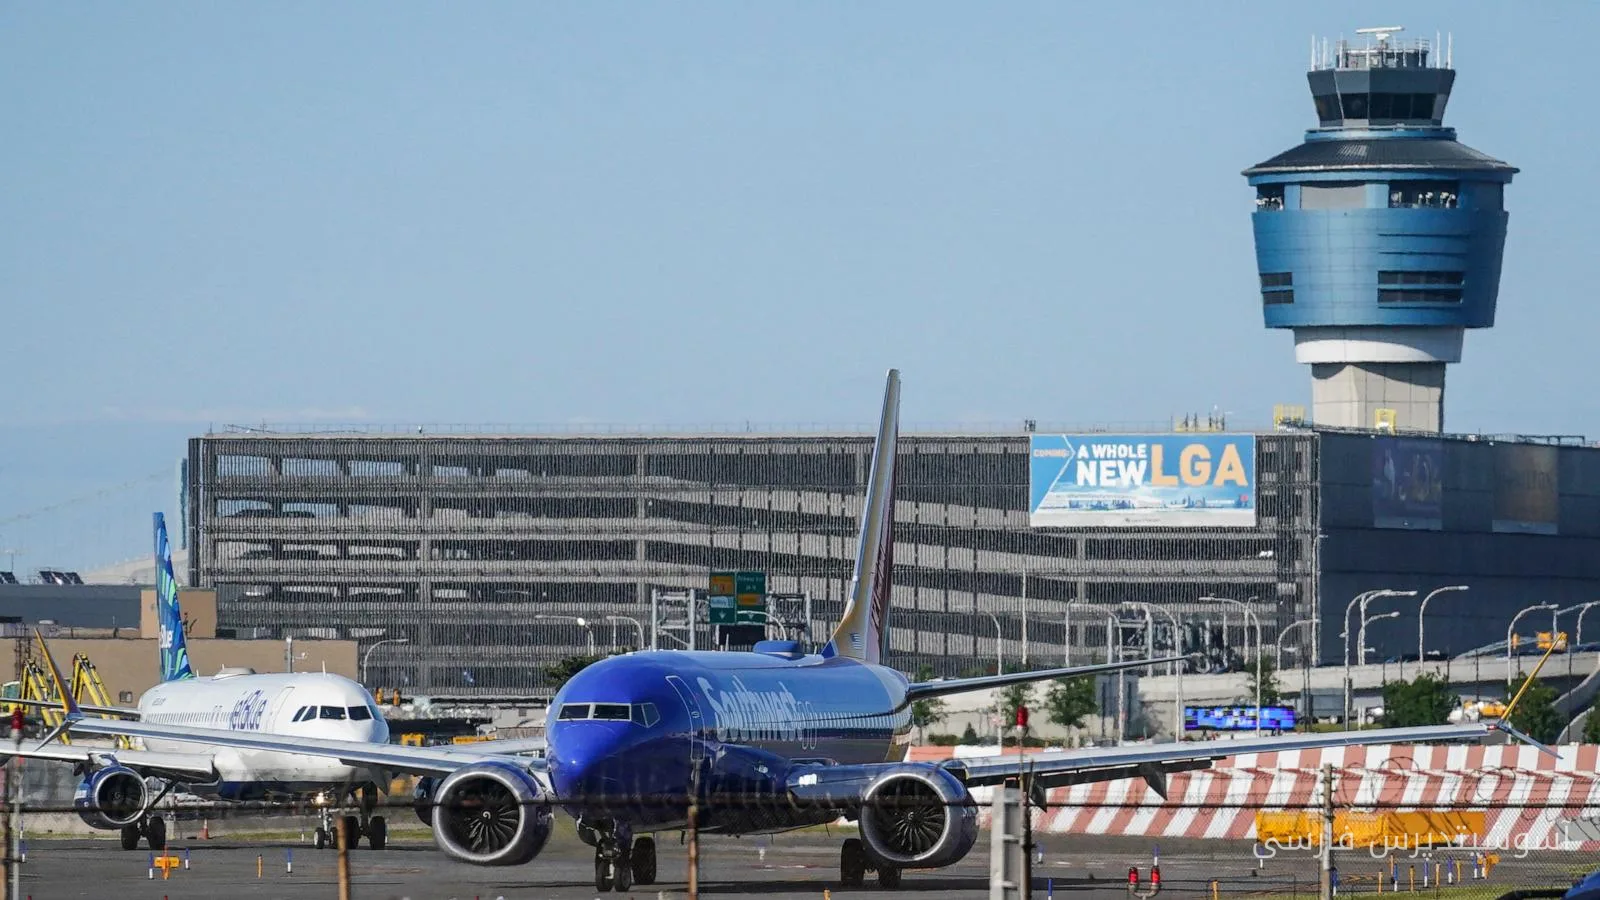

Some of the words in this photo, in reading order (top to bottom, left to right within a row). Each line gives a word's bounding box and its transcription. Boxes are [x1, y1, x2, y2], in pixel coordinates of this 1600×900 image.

[1077, 444, 1089, 459] A
[1091, 444, 1147, 459] WHOLE
[1151, 443, 1248, 487] LGA
[1077, 460, 1147, 486] NEW
[697, 674, 802, 742] Southwest
